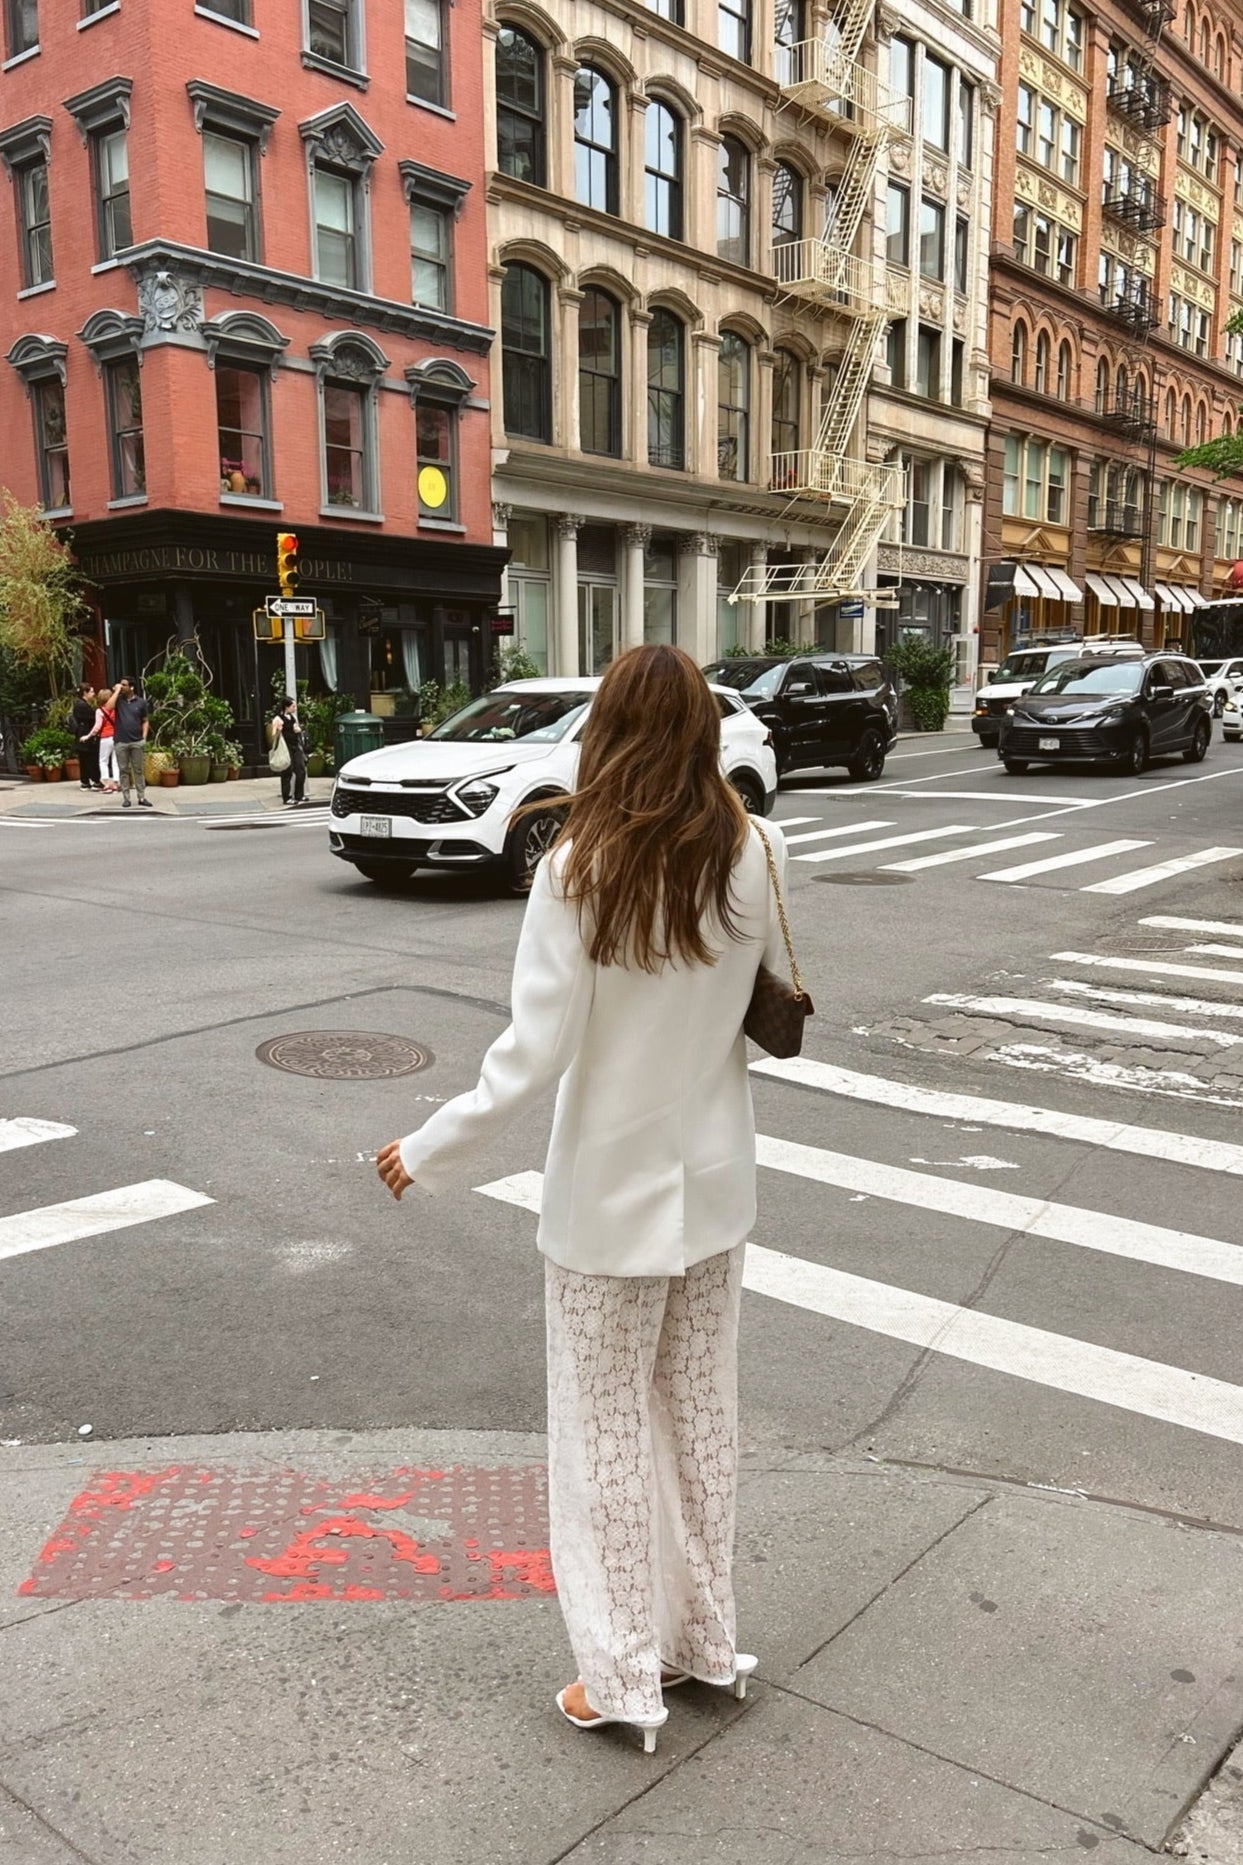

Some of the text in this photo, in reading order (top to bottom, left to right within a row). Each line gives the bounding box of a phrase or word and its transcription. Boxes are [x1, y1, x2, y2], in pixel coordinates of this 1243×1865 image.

[80, 547, 352, 581] CHAMPAGNE FOR THE OPLE!
[274, 602, 310, 612] ONE WAY
